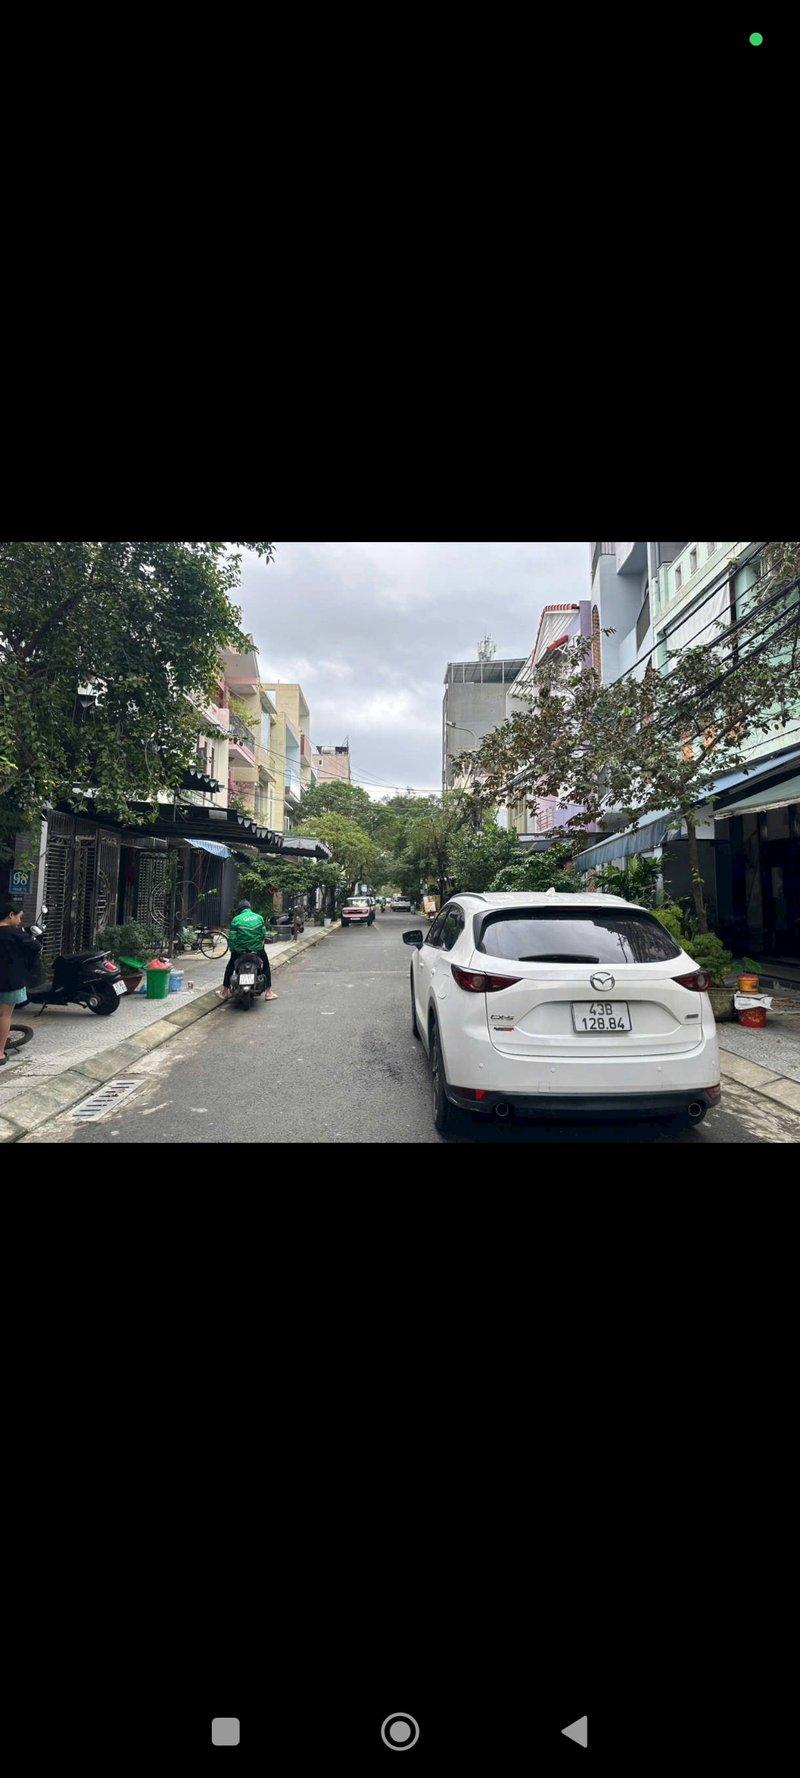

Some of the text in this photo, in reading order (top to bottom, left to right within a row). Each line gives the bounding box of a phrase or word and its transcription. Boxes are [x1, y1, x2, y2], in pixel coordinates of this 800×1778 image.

[13, 872, 28, 886] 98
[589, 1003, 613, 1015] 43B
[582, 1017, 625, 1030] 128.84
